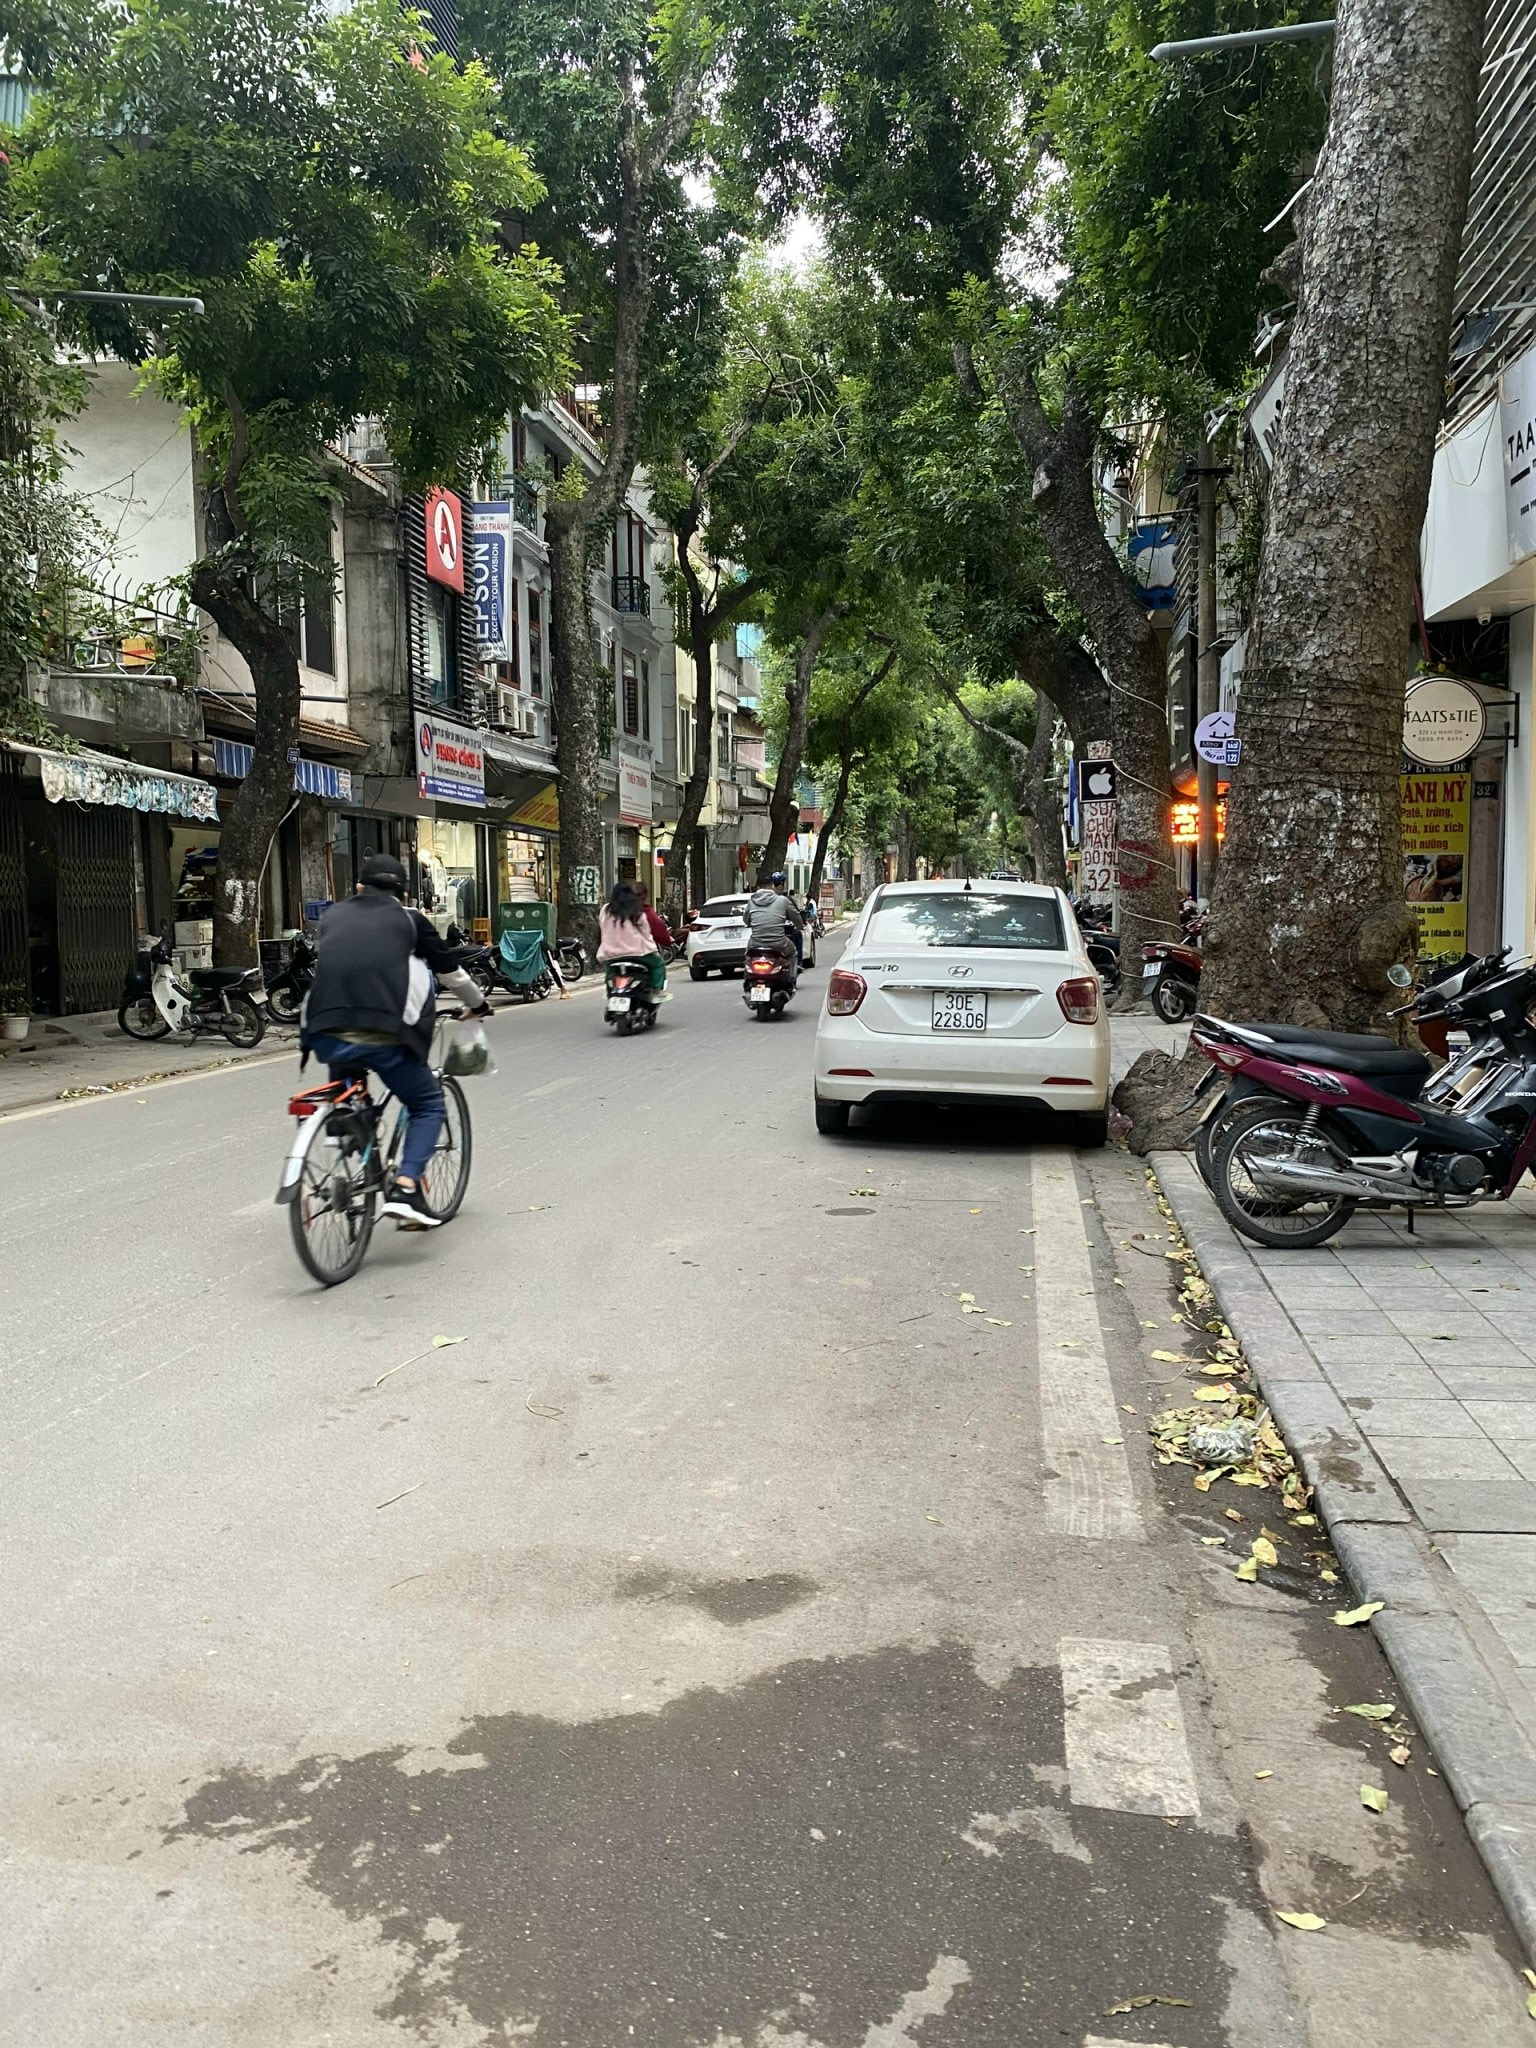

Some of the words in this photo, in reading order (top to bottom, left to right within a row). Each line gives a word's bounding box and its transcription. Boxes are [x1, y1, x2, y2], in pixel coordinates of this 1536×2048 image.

[1456, 710, 1478, 722] TIE
[1402, 776, 1438, 804] ÁNH
[576, 869, 596, 888] 79
[946, 994, 974, 1011] 30E
[934, 1011, 984, 1029] 228.06
